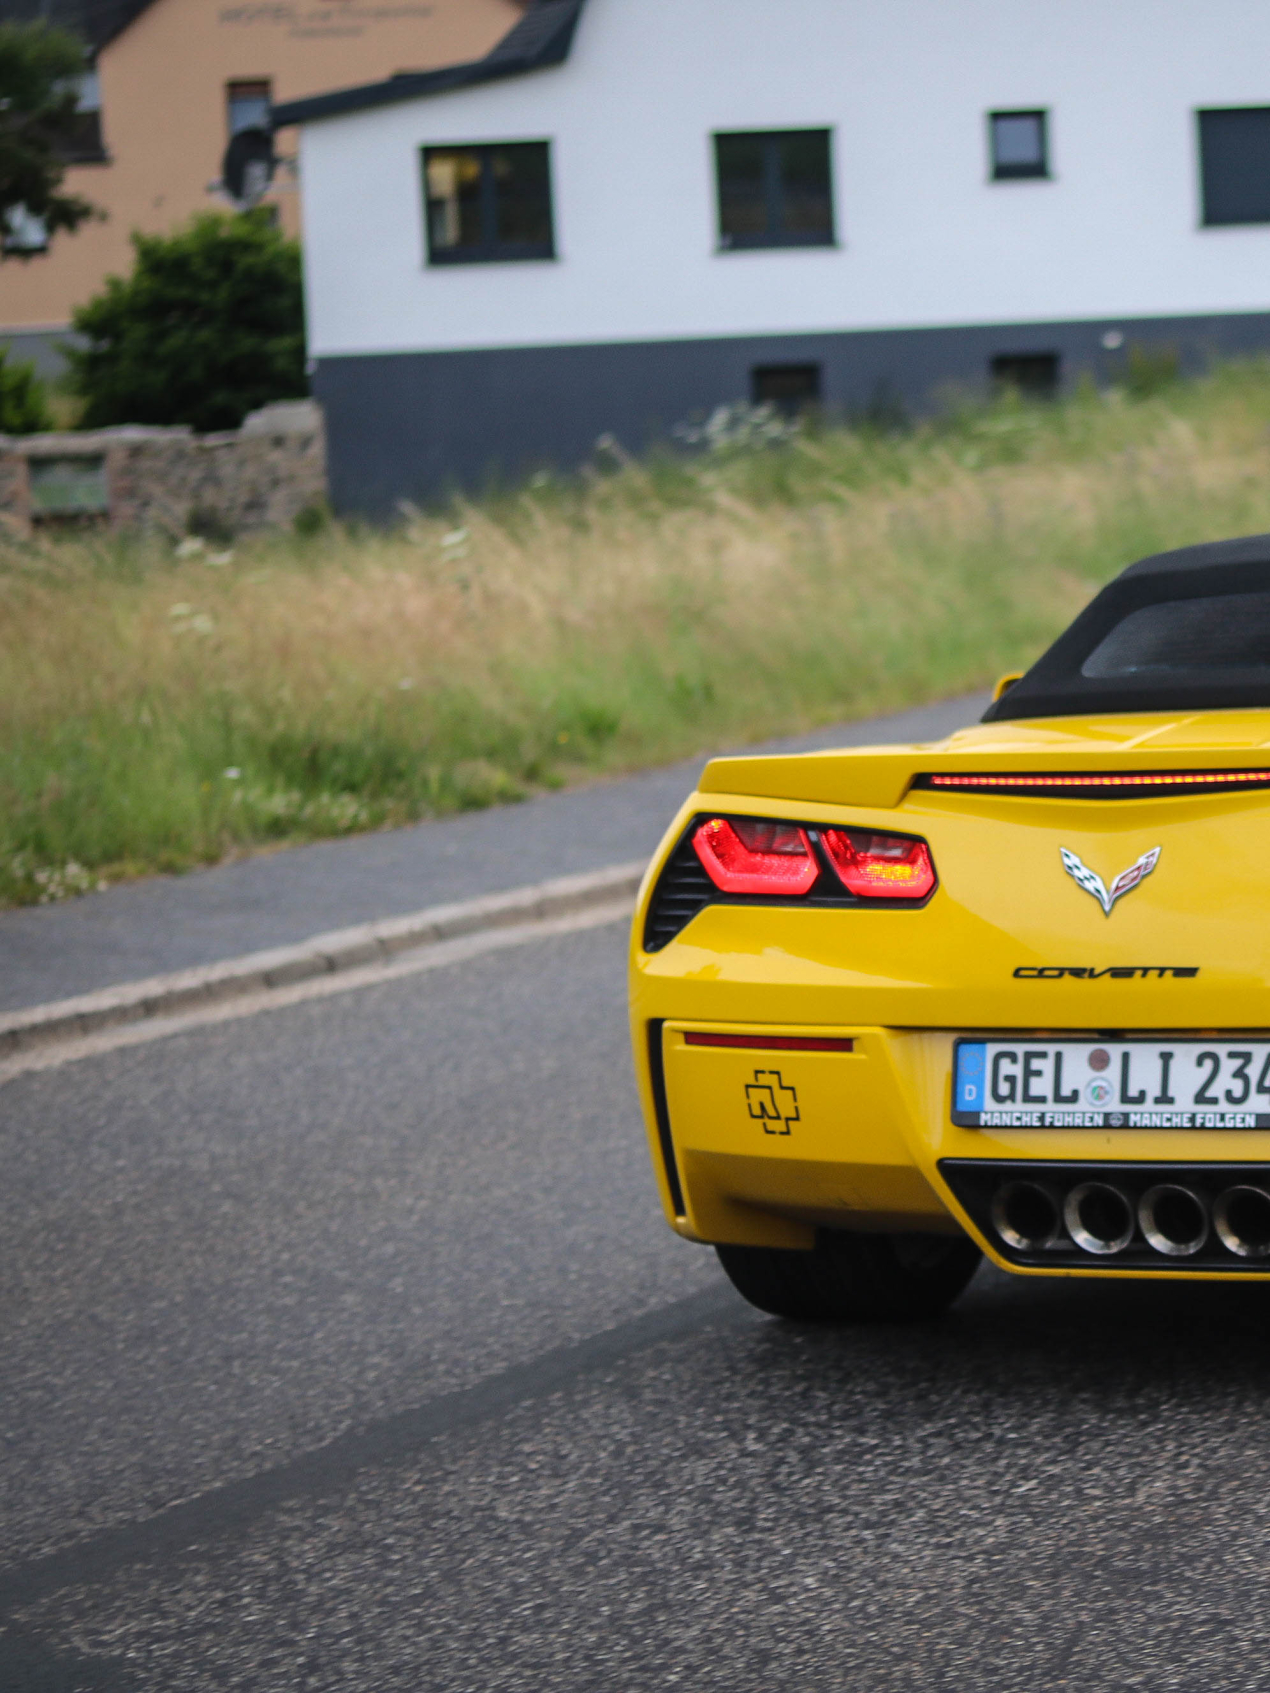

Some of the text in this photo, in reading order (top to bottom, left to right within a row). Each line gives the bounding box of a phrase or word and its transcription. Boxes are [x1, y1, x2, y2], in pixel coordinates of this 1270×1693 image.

[1012, 966, 1200, 979] CORVETTE
[992, 1052, 1079, 1104] GEL
[1119, 1052, 1175, 1105] LI
[965, 1085, 977, 1101] D
[980, 1112, 1042, 1127] MANCHE
[1129, 1112, 1192, 1127] MANCHE
[1195, 1113, 1257, 1128] FOLGEN
